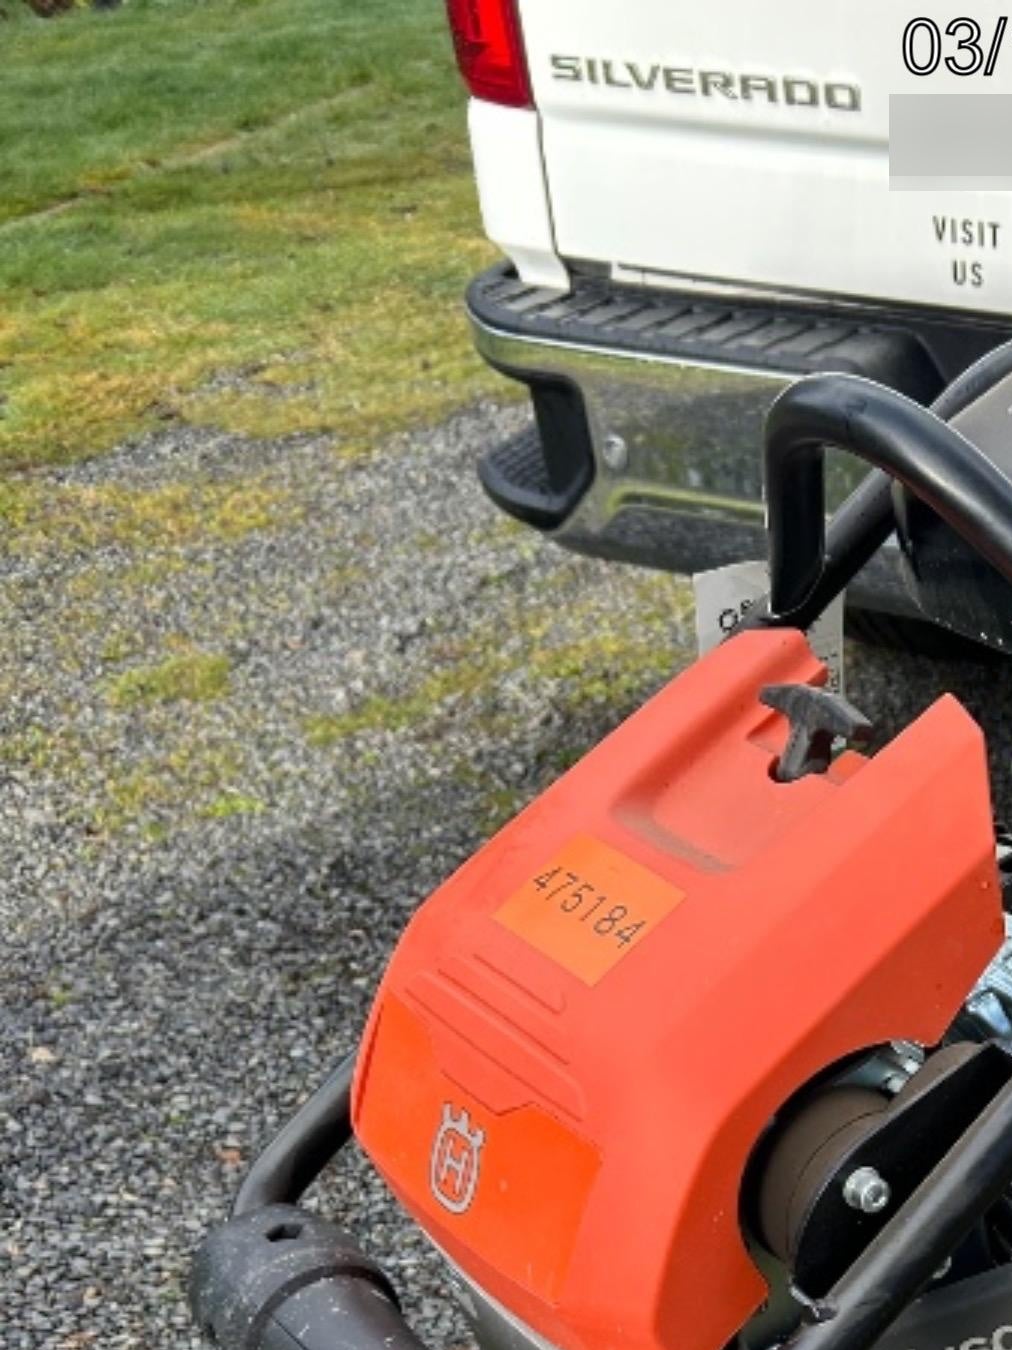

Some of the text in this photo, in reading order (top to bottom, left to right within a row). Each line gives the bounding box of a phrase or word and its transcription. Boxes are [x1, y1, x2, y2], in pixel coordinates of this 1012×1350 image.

[550, 54, 862, 112] SILVERADO
[932, 215, 1000, 250] VISIT
[953, 258, 984, 288] US
[533, 866, 646, 949] 475184
